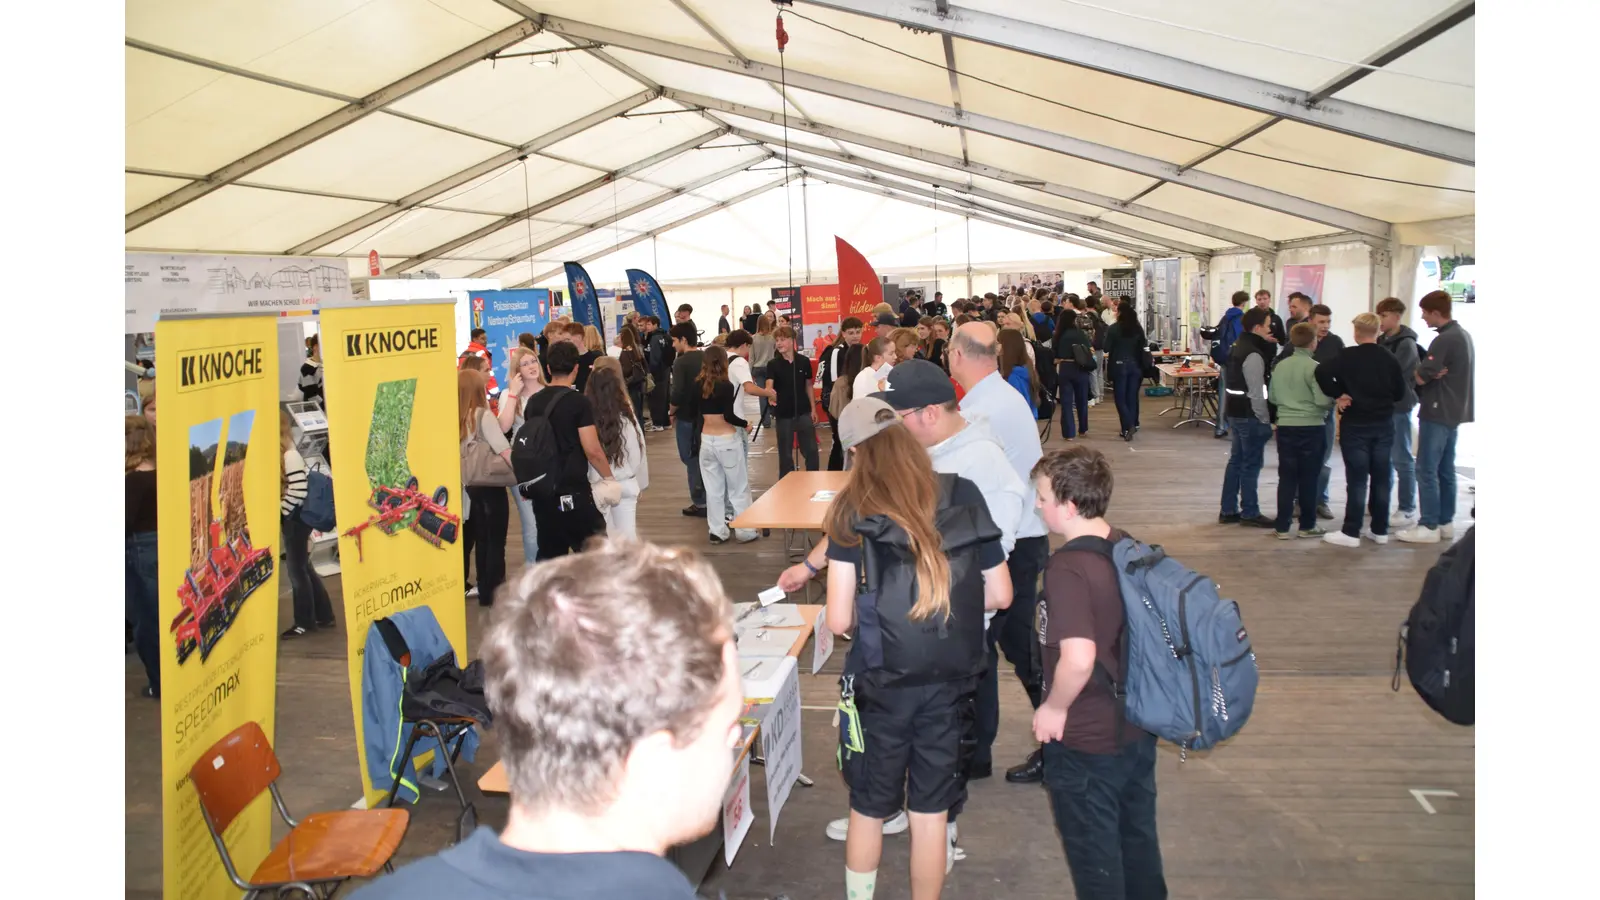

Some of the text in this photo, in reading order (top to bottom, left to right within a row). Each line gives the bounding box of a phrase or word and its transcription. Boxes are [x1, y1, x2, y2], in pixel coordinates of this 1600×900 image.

[853, 282, 869, 296] Wir
[1105, 279, 1134, 290] DEINE
[259, 299, 283, 307] MACHEN
[283, 298, 300, 306] SCHULE
[366, 328, 438, 355] KNOCHE
[199, 348, 262, 384] KNOCHE
[355, 578, 423, 621] FIELDMAX
[175, 668, 241, 745] SPEEDMAX
